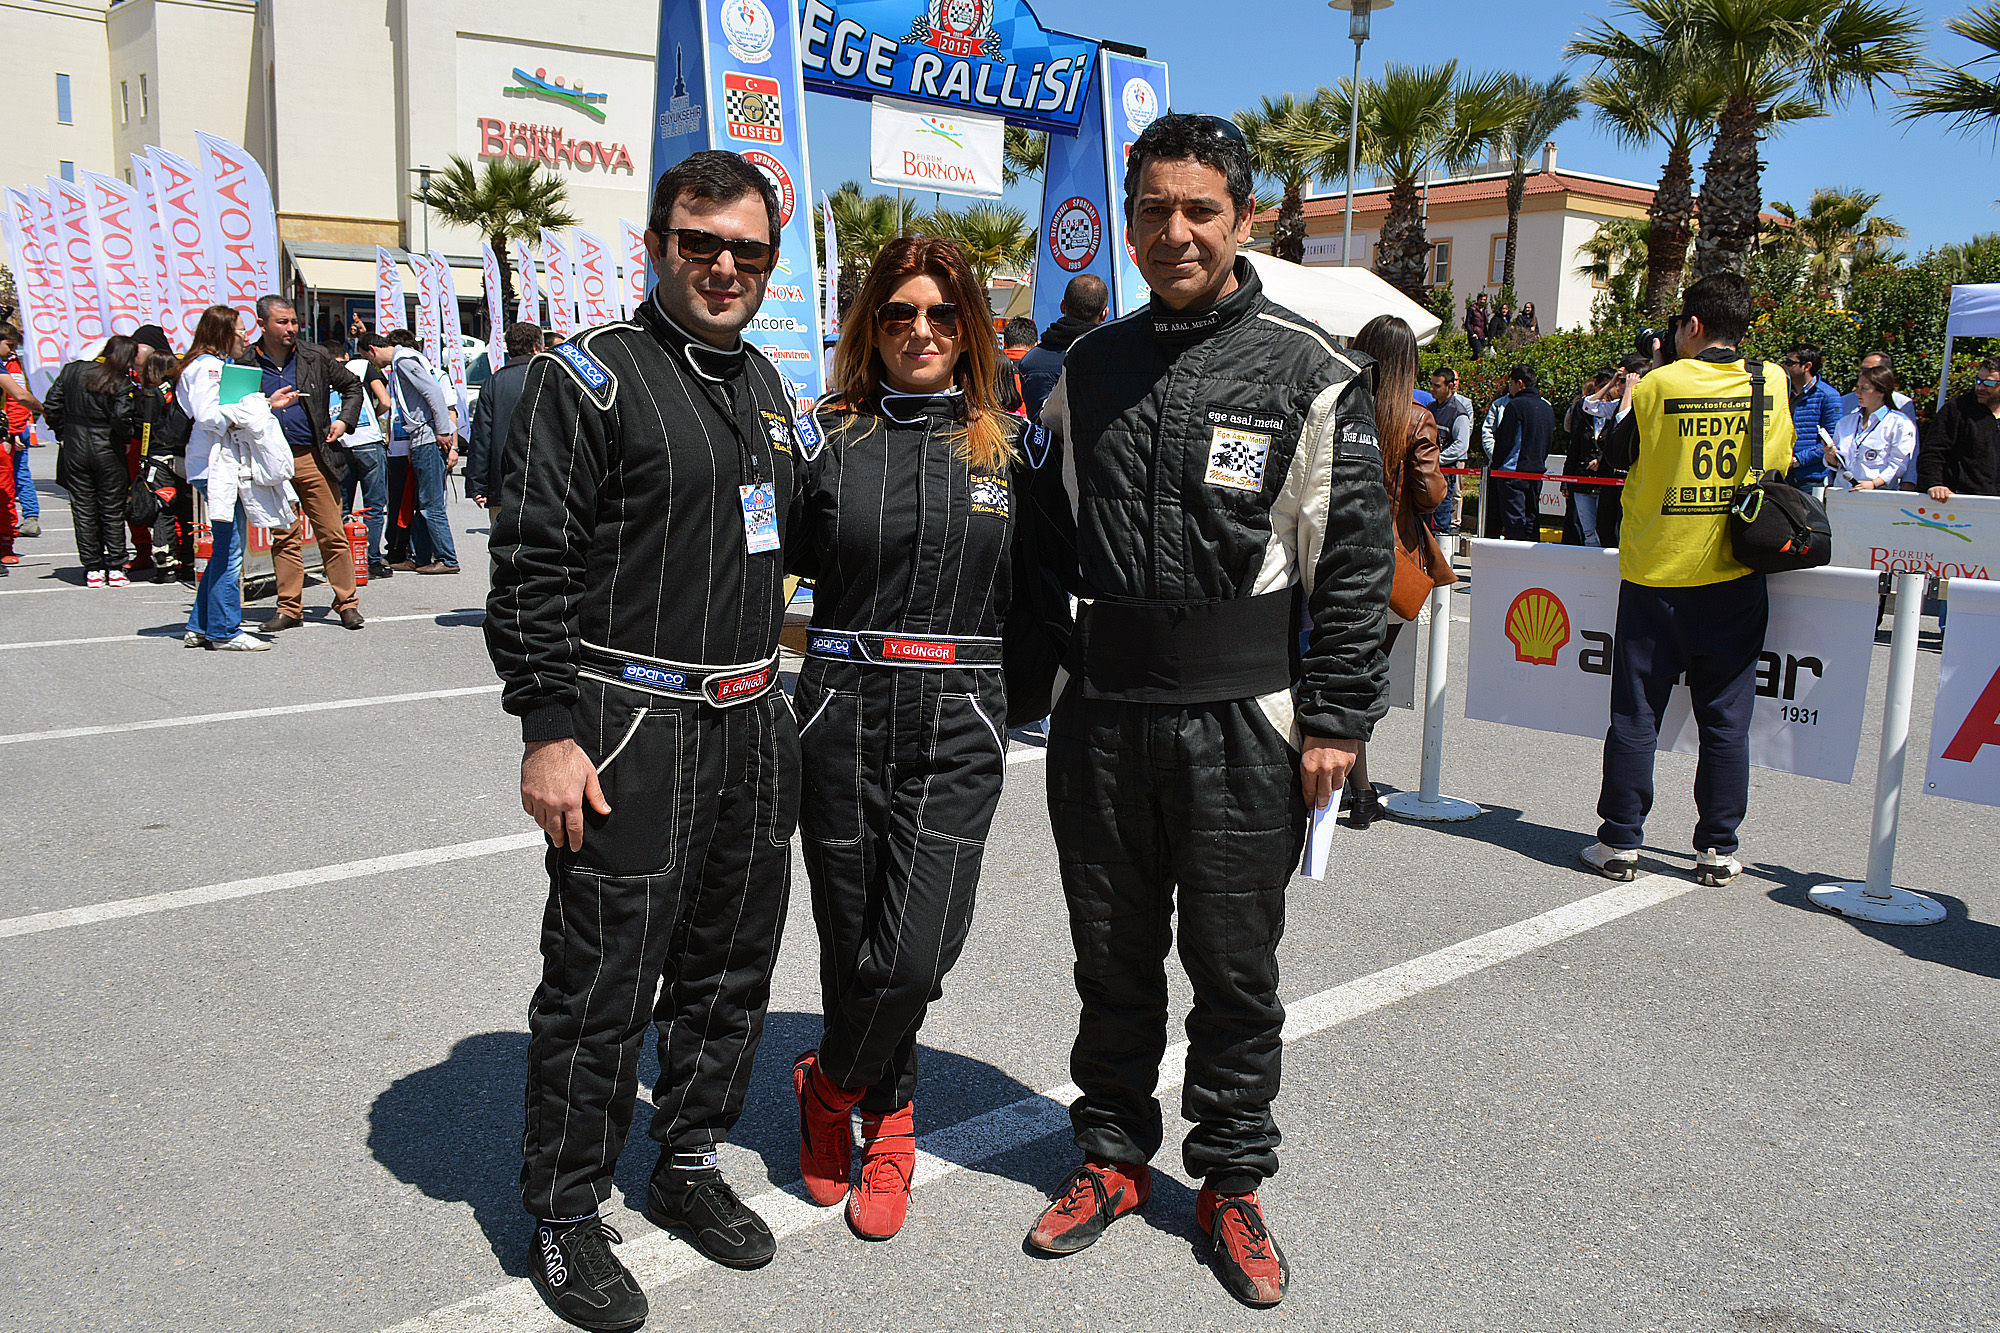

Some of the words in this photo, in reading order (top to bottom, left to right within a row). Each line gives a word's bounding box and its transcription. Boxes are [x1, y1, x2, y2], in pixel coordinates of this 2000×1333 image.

[801, 0, 899, 86] EGE
[941, 38, 969, 54] 2015
[510, 121, 563, 137] FORUM
[732, 123, 779, 141] TOSFED
[478, 118, 635, 169] BORNOVA
[902, 150, 976, 184] BORNOVA
[916, 153, 943, 164] FORUM
[750, 318, 794, 330] ncore
[562, 345, 604, 384] sparco
[1677, 401, 1751, 410] www.tosfed.org
[1208, 411, 1228, 422] ege
[1229, 415, 1252, 426] asal
[1253, 418, 1284, 431] metal
[1678, 416, 1749, 437] MEDYA
[1692, 439, 1737, 480] 66
[1892, 549, 1934, 561] FORUM
[812, 637, 849, 651] sparco
[890, 644, 901, 655] Y.
[626, 665, 684, 686] sparco
[1781, 705, 1819, 726] 1931
[539, 1226, 568, 1287] OMP
